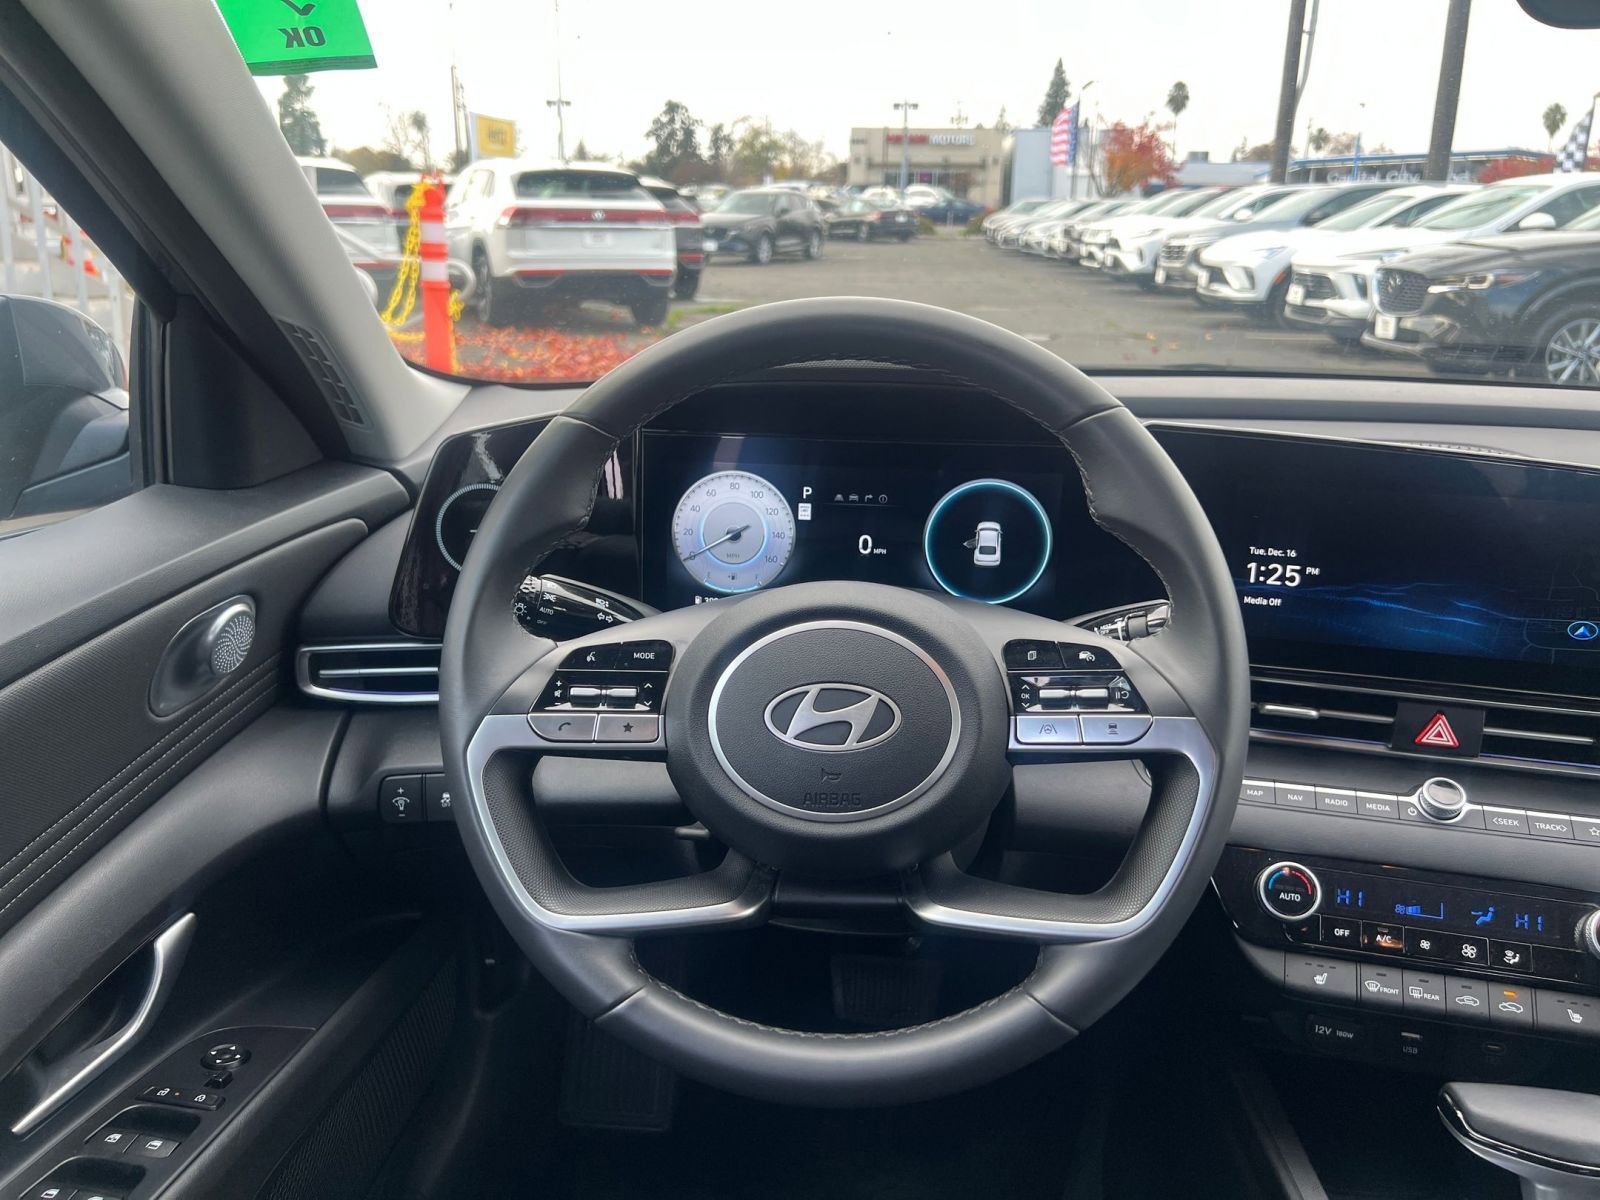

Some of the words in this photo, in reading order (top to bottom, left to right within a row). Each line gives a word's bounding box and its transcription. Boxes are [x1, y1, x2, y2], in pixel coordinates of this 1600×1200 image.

[1327, 170, 1380, 185] Caital
[729, 481, 740, 490] 80
[706, 488, 717, 497] 60
[751, 490, 764, 499] 100
[803, 486, 812, 499] P
[690, 505, 701, 513] 40
[766, 507, 779, 516] 120
[683, 528, 694, 537] 20
[772, 531, 786, 540] 140
[858, 534, 872, 554] 0
[1286, 549, 1297, 558] 16
[765, 555, 778, 563] 160
[1247, 562, 1301, 587] 1:25
[1305, 566, 1320, 575] PM
[1243, 596, 1268, 605] Media
[1269, 598, 1282, 606] Off
[540, 606, 553, 615] AUTO
[633, 651, 656, 661] MODE
[1020, 691, 1031, 701] OK
[1246, 788, 1264, 797] MAP
[802, 791, 863, 807] AIRBAG
[1287, 793, 1303, 802] NAV
[1325, 798, 1348, 806] RADIO
[1366, 803, 1391, 811] MEDIA
[1279, 891, 1301, 902] AUTO
[1334, 928, 1350, 937] OFF
[1375, 934, 1392, 943] A/C
[1379, 987, 1399, 995] FRONT
[1314, 1024, 1332, 1035] 12V
[1402, 1046, 1418, 1054] USB
